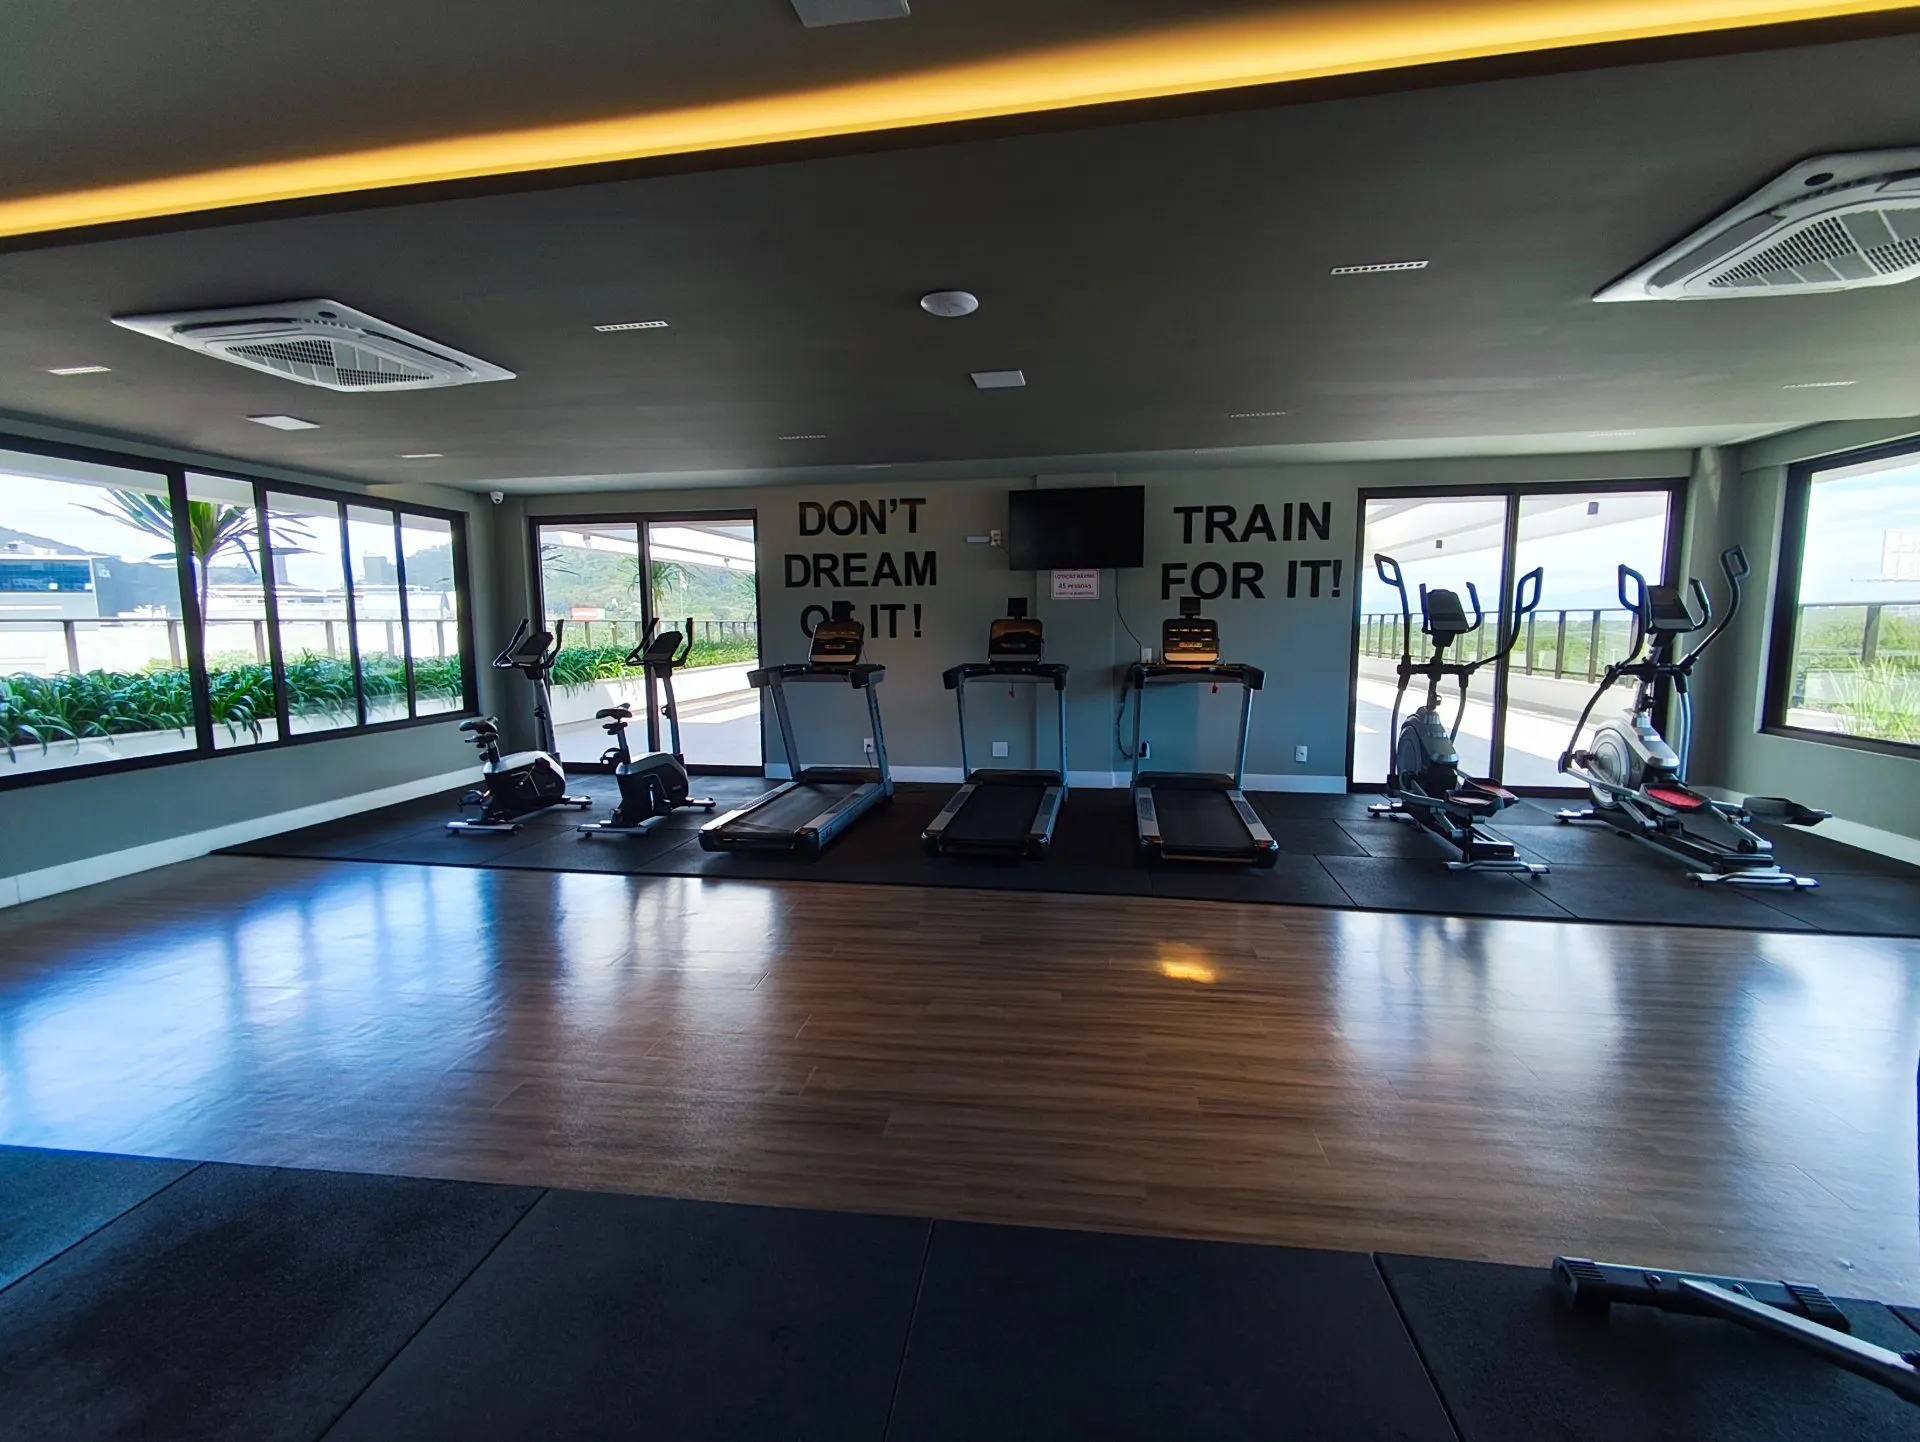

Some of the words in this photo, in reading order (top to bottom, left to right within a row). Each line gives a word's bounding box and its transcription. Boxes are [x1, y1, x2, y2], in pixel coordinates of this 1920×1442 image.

[799, 498, 926, 536] DON'T
[1173, 502, 1331, 544] TRAIN
[784, 551, 937, 587] DREAM
[1161, 561, 1265, 600] FOR
[1287, 559, 1342, 598] IT!
[871, 604, 922, 638] IT!
